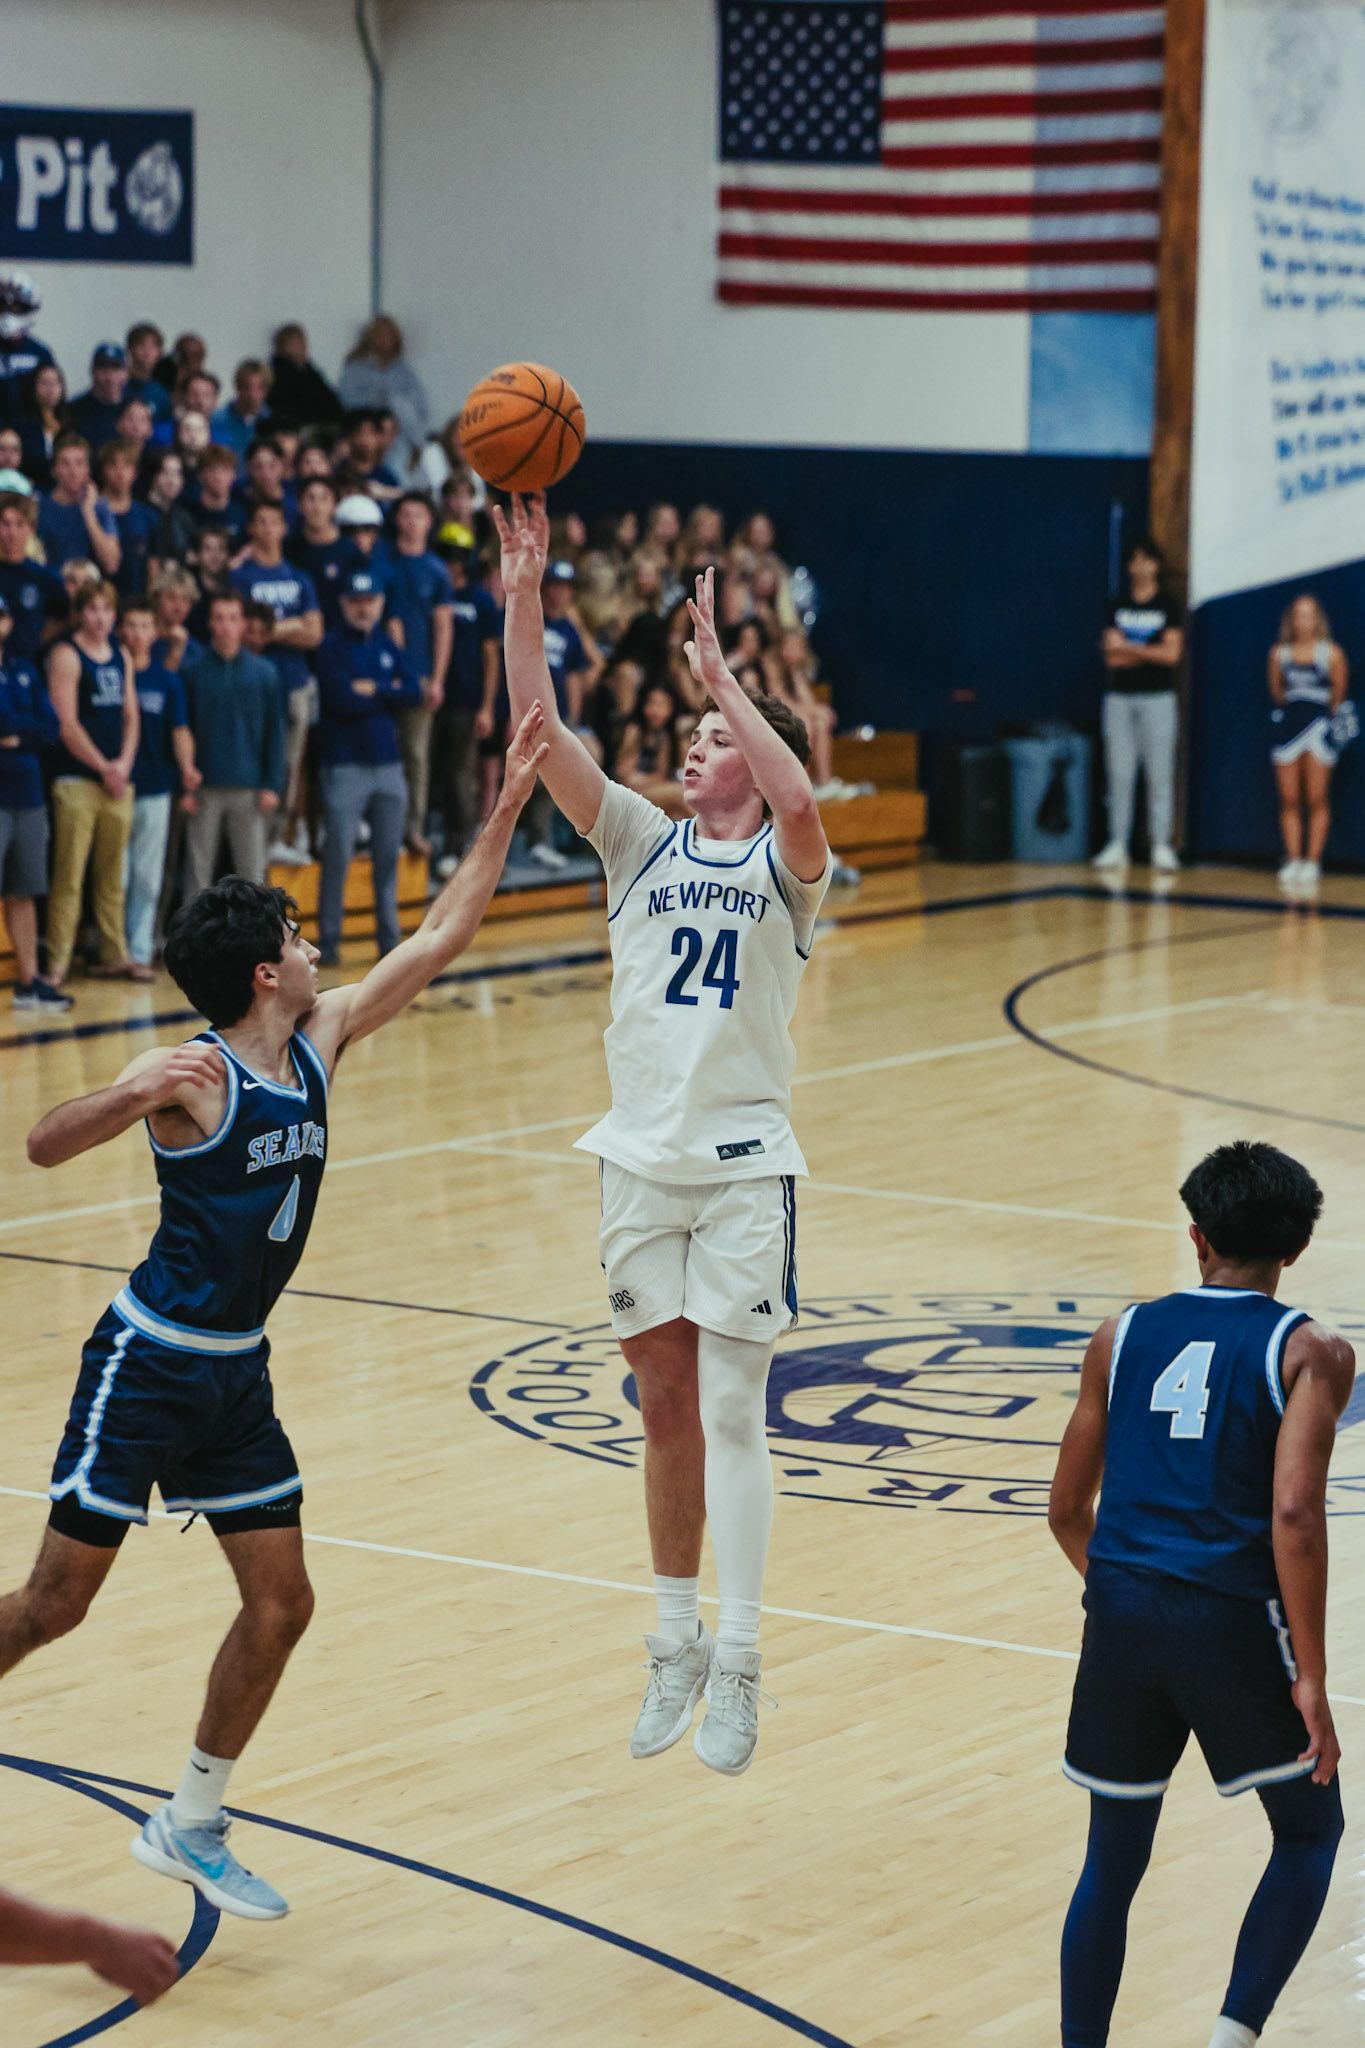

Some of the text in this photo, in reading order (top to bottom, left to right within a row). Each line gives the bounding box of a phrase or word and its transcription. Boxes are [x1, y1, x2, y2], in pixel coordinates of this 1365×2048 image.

[15, 134, 119, 235] Pit
[648, 881, 771, 923] NEWPORT
[665, 927, 740, 1010] 24
[1150, 1341, 1216, 1439] 4
